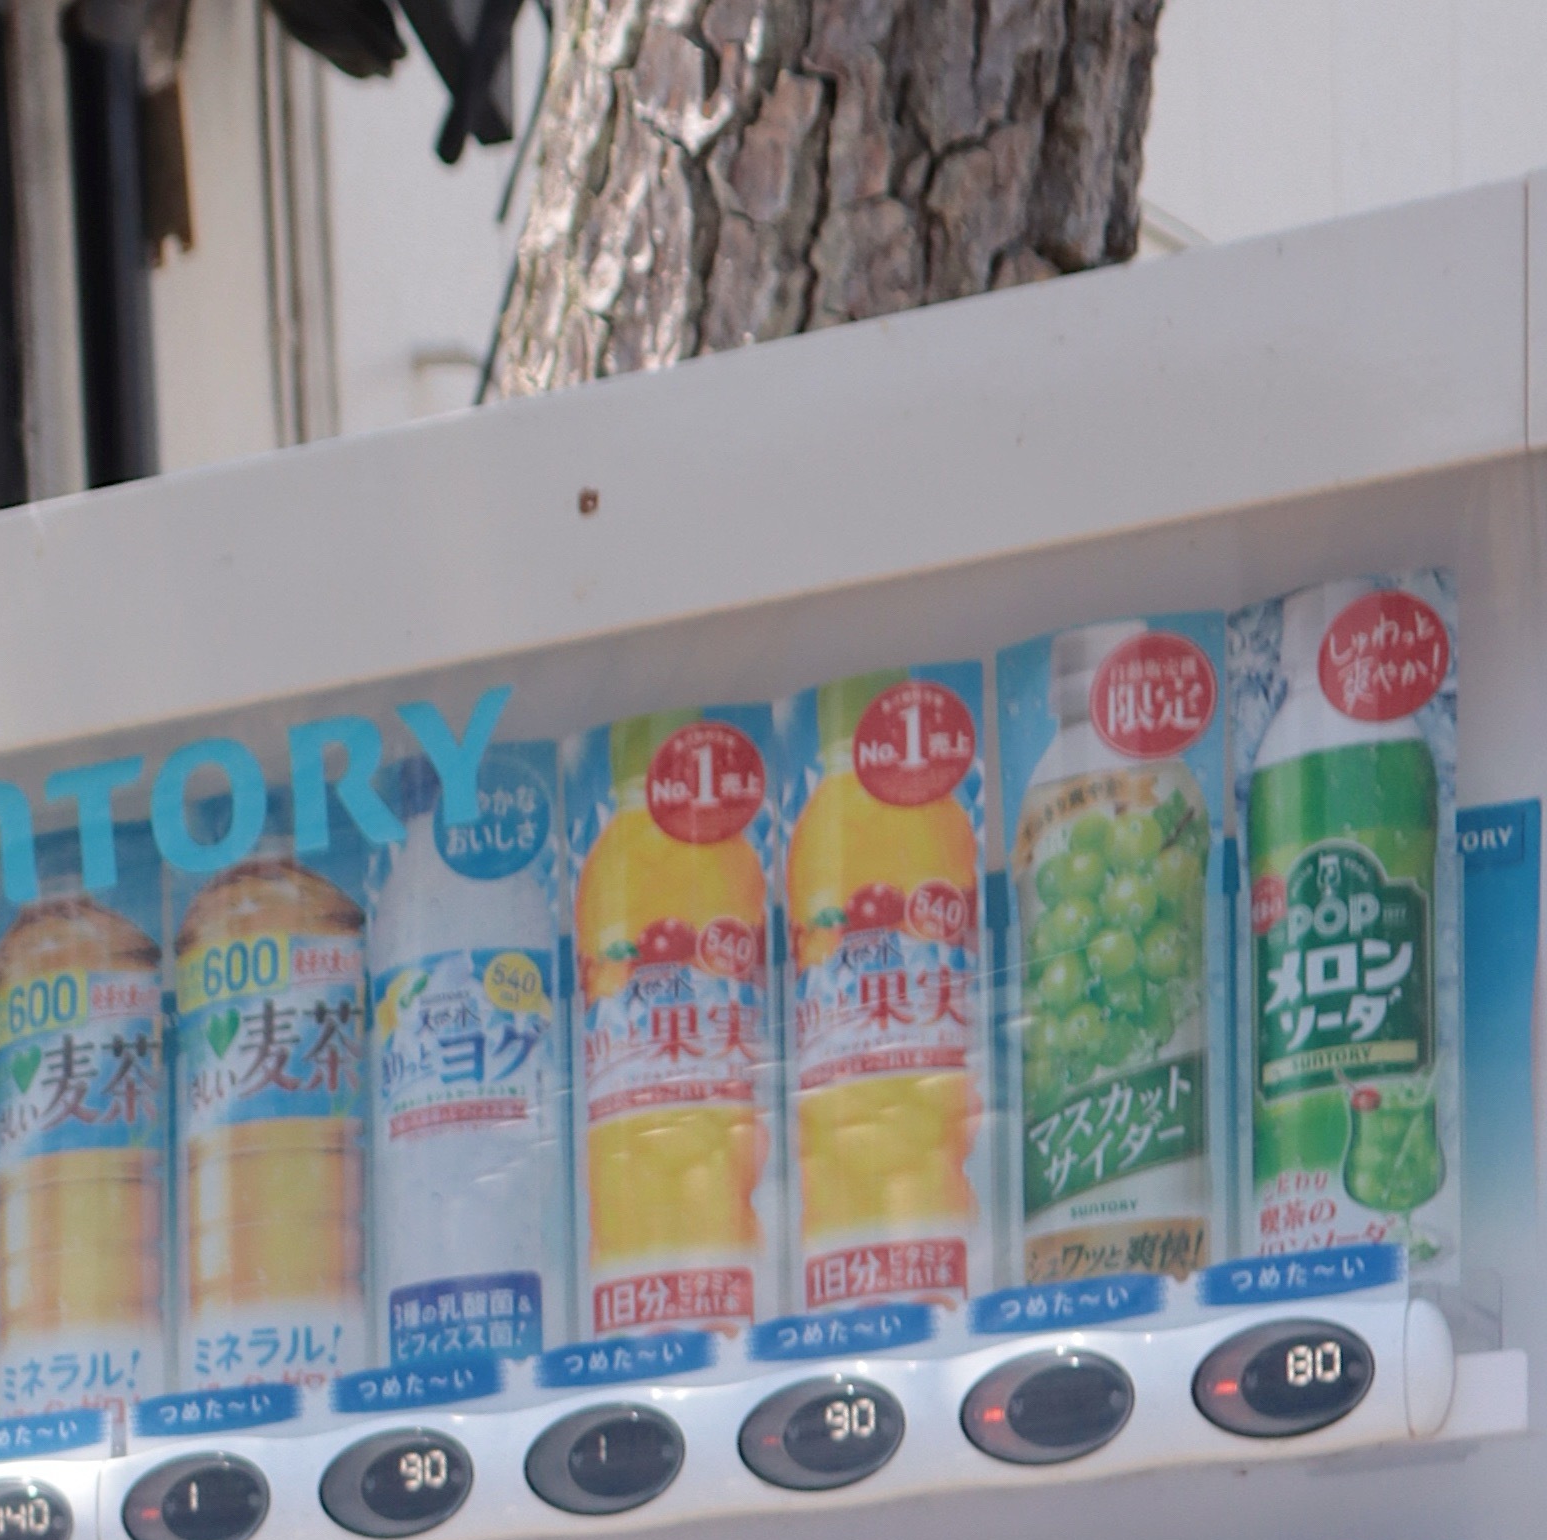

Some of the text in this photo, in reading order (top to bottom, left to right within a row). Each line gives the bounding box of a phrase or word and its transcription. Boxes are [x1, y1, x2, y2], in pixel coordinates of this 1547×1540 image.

[1108, 680, 1203, 735] 限定
[1288, 893, 1380, 945] POP
[204, 937, 278, 995] 600
[858, 965, 967, 1030] 果実
[1264, 938, 1412, 1015] メロン
[10, 974, 78, 1034] 600
[647, 1000, 761, 1063] 果実
[1280, 985, 1402, 1050] ソーダ
[238, 999, 362, 1097] 麦茶
[42, 1033, 163, 1131] 麦茶
[1030, 1066, 1191, 1155] マスカット
[1043, 1107, 1186, 1195] サイダー
[3, 1350, 140, 1401] ミネラル!
[195, 1324, 343, 1375] ミネラル!
